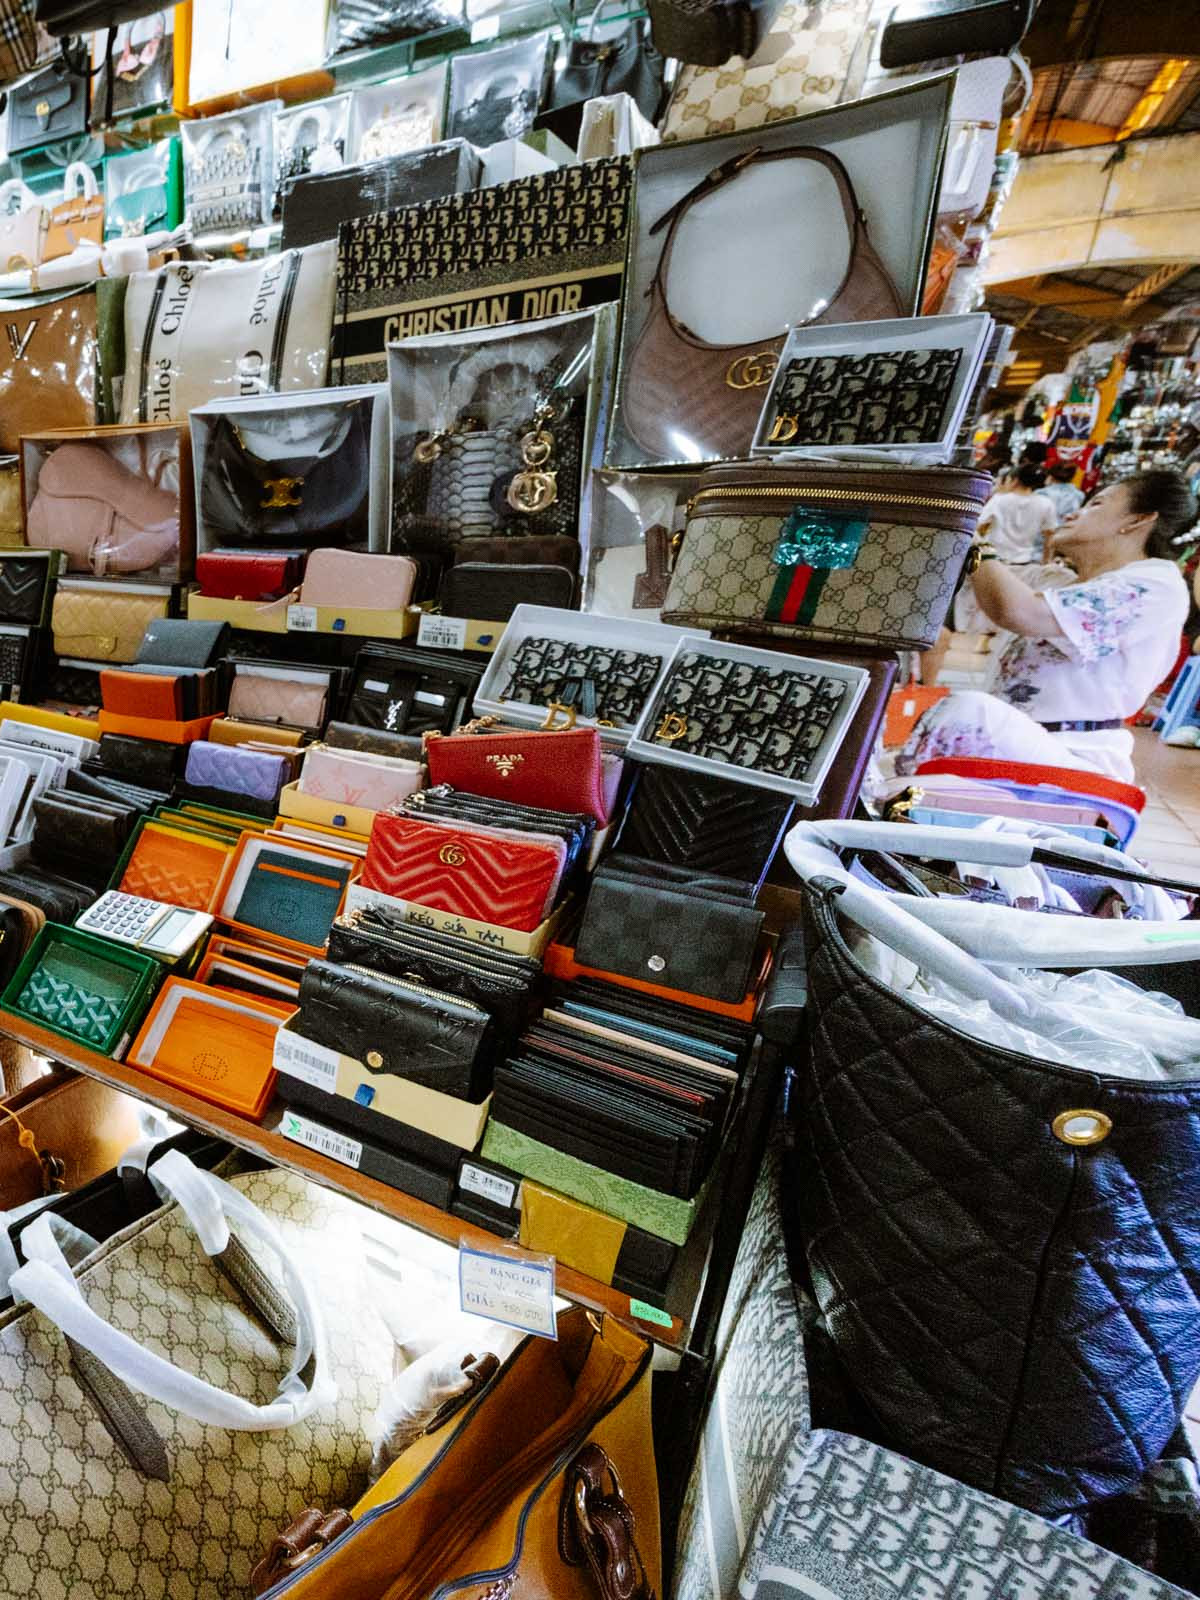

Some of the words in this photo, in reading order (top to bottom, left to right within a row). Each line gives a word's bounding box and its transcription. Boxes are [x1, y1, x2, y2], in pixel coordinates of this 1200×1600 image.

[384, 296, 510, 343] CHRISTIAN
[522, 284, 583, 321] DIOR
[485, 753, 525, 763] PRADA
